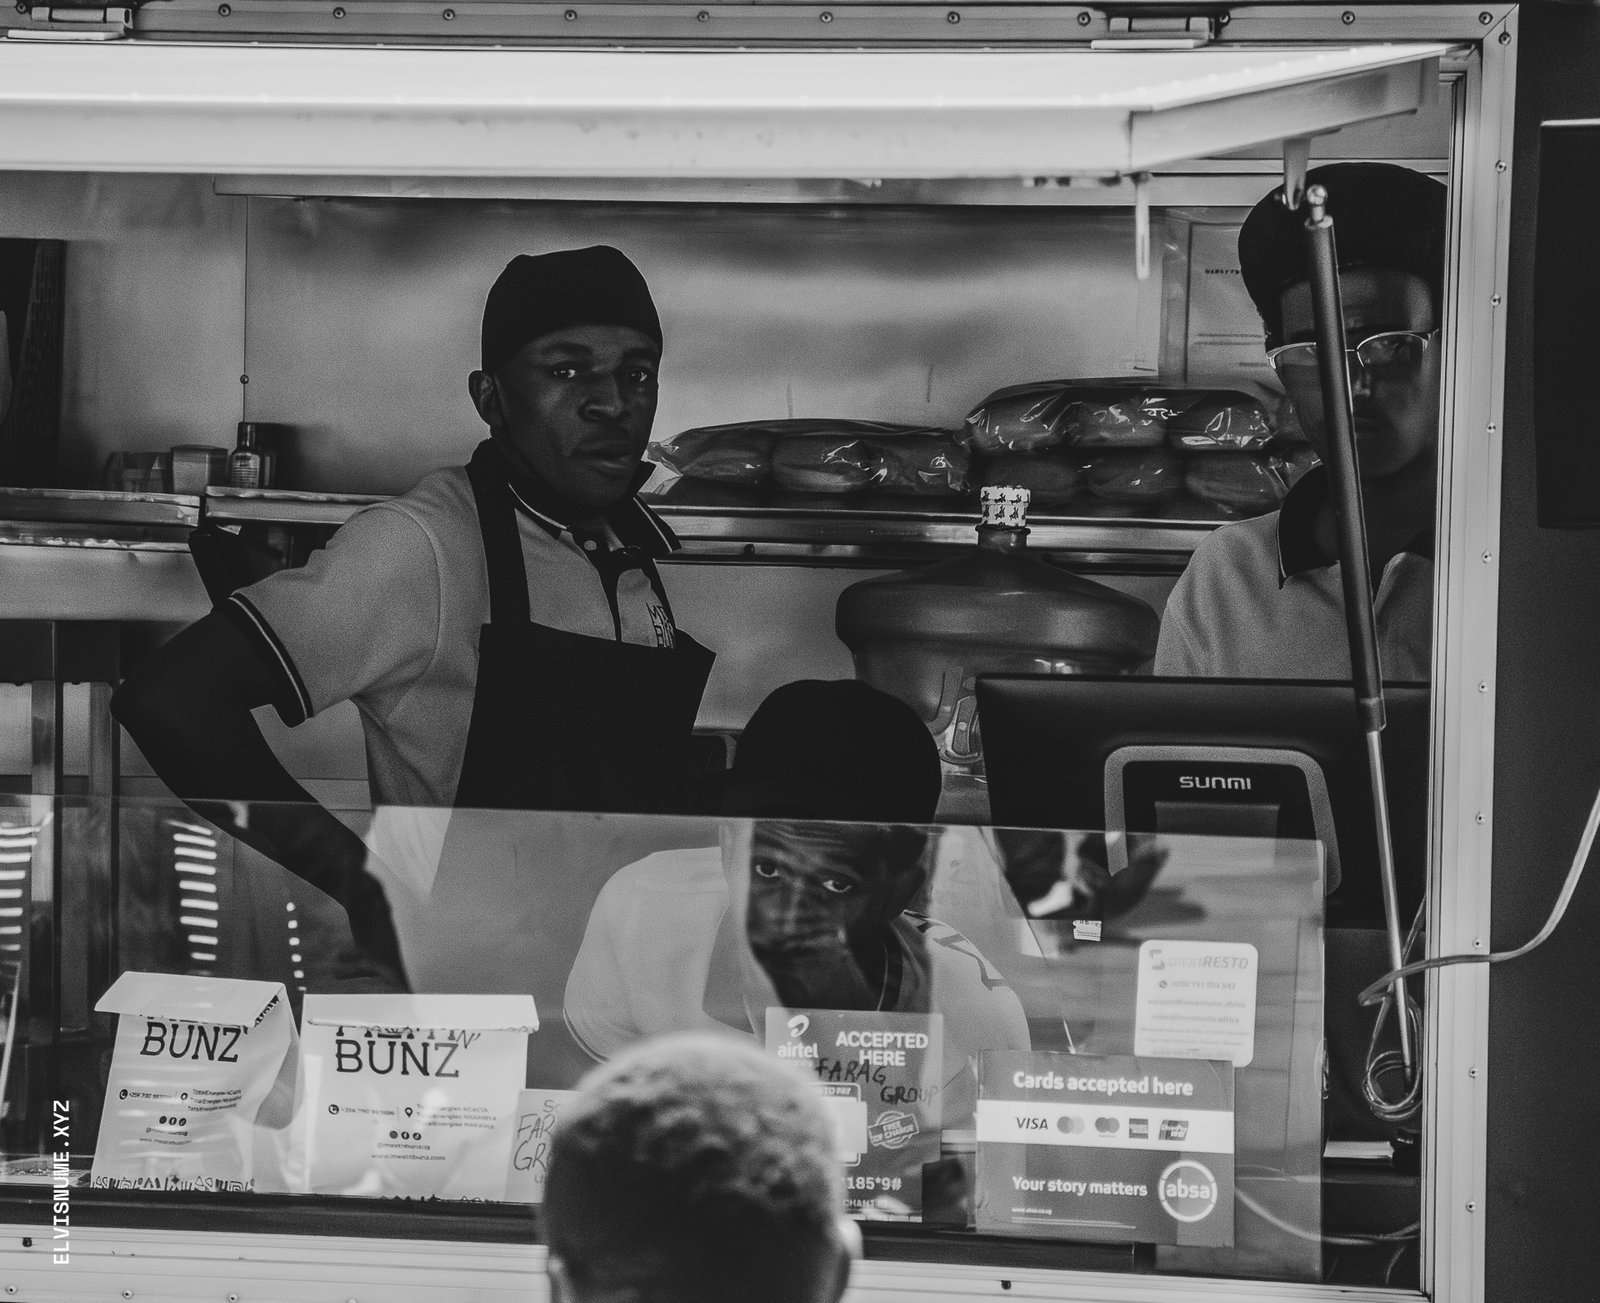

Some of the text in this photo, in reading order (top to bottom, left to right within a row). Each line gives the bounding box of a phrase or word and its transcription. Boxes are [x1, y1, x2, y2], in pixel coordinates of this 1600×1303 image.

[139, 1021, 240, 1063] BUNZ
[777, 1042, 819, 1058] airtel
[835, 1031, 929, 1049] ACCEPTED
[335, 1039, 460, 1078] BUNZ
[859, 1050, 906, 1066] HERE
[815, 1057, 887, 1086] FARAG
[1013, 1071, 1194, 1097] Cards accepted here
[1016, 1117, 1049, 1130] VISA
[1012, 1176, 1148, 1196] Your story matters
[1166, 1178, 1211, 1199] absa
